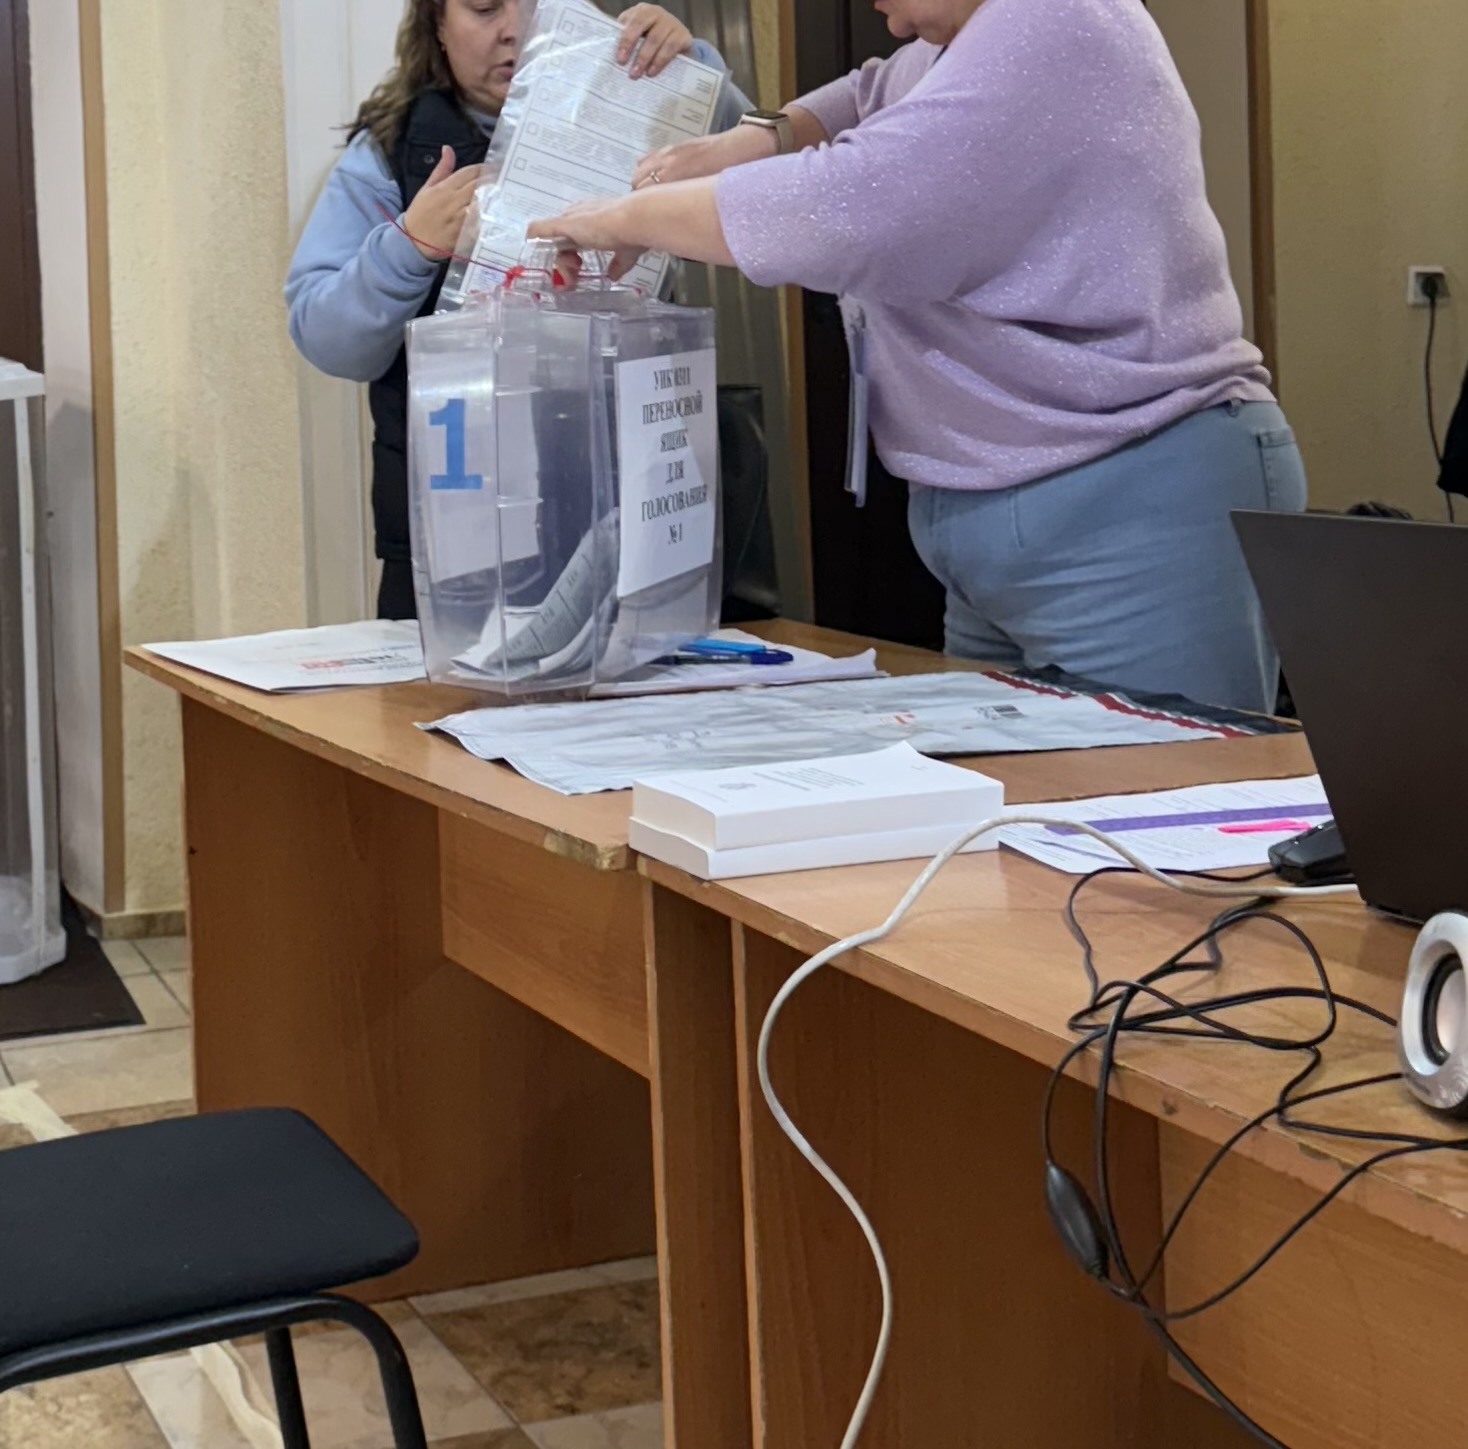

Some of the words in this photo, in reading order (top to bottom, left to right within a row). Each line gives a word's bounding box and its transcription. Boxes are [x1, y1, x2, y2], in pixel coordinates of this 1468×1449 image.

[642, 390, 703, 424] ПЕРЕНОСНОЙ
[429, 399, 483, 490] 1
[660, 428, 688, 452] ЯЩИК
[665, 460, 684, 484] ДЛЯ
[641, 484, 707, 521] ГОЛОСОВАНИЯ
